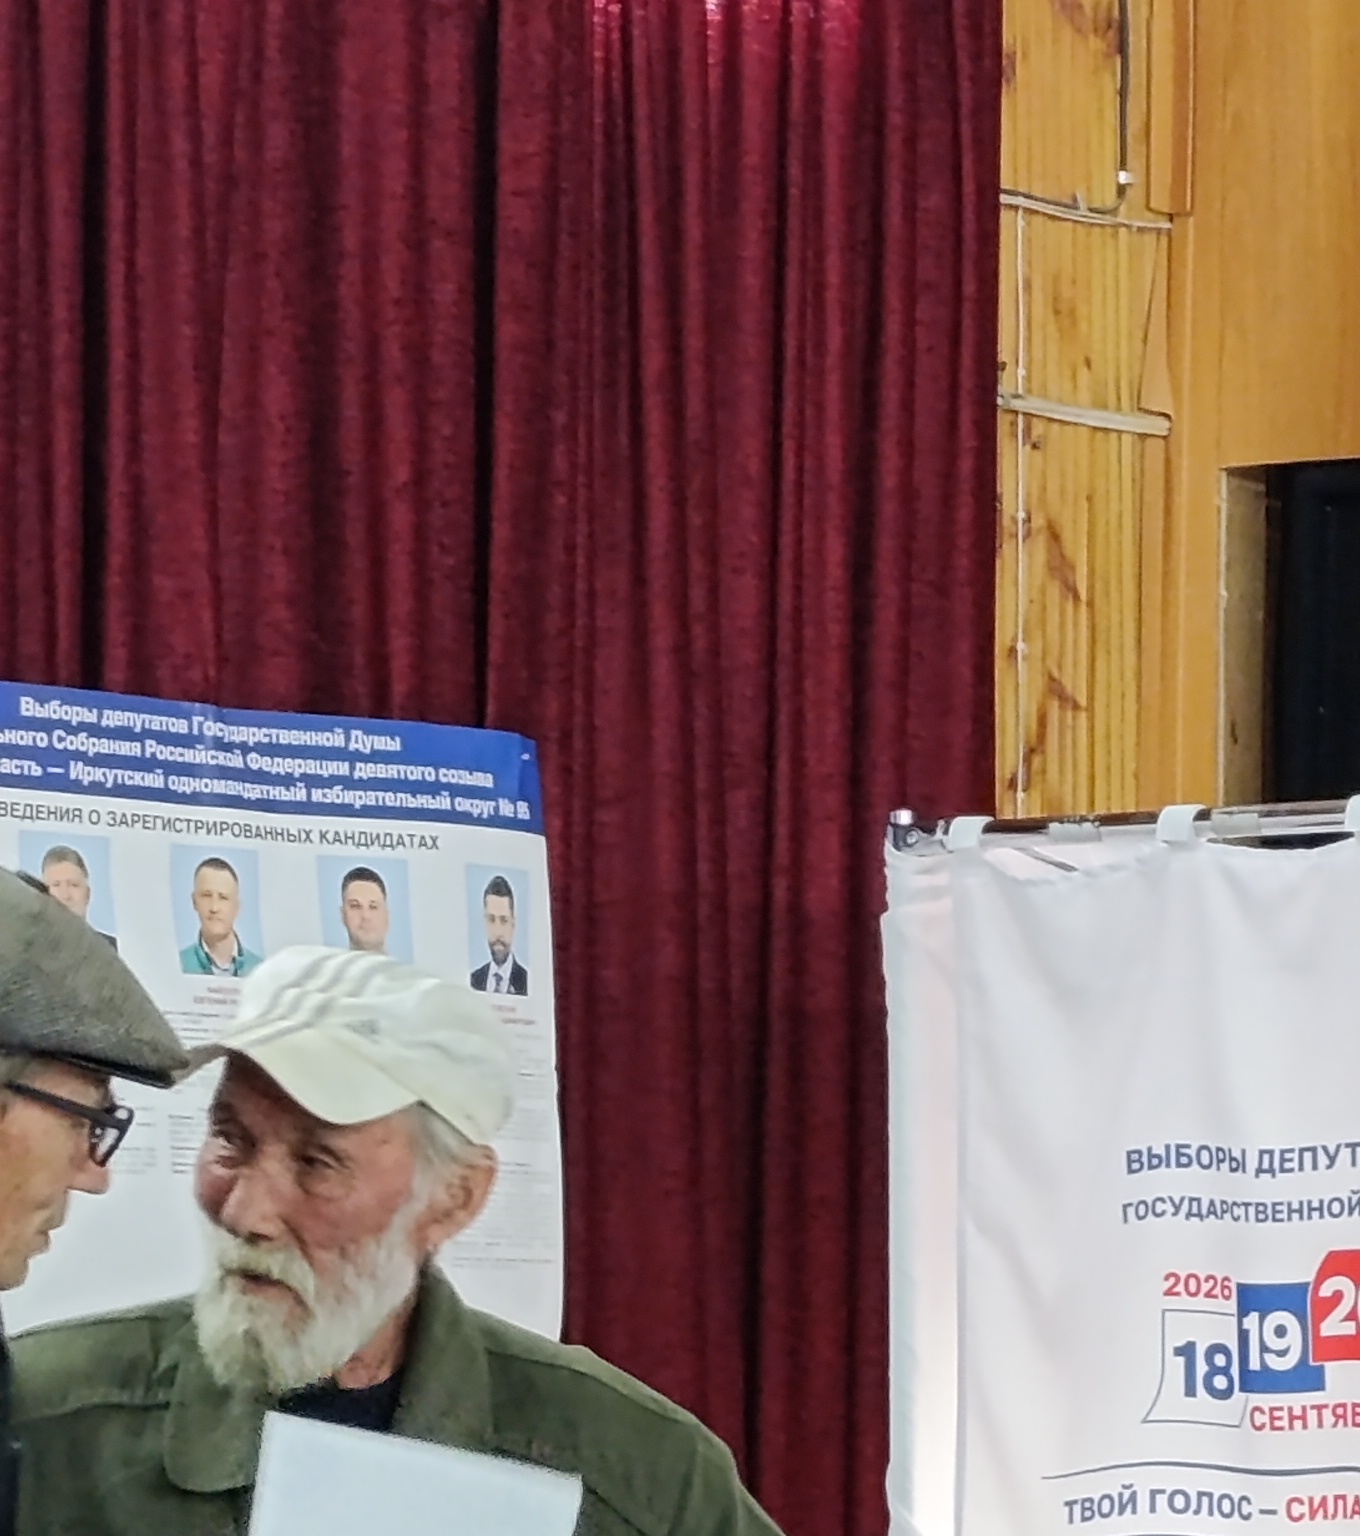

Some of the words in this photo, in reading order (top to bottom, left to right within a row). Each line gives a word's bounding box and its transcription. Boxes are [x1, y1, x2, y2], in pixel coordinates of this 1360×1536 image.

[19, 696, 98, 727] Выборы
[101, 709, 189, 734] депутатов
[191, 715, 345, 749] Государственной
[348, 729, 402, 754] Думы
[52, 729, 141, 758] Собрания
[144, 738, 244, 768] Российской
[246, 752, 351, 779] Федерации
[353, 759, 436, 782] девятого
[69, 760, 165, 790] Иркутский
[311, 786, 452, 811] избирательный
[454, 796, 496, 819] округ
[88, 809, 101, 826] О
[107, 810, 313, 845] ЗАРЕГИСТРИРОВАННЫХ
[319, 828, 439, 852] КАНДИДАТАХ
[1125, 1142, 1247, 1176] ВЫБОРЫ
[1162, 1272, 1233, 1301] 2026
[1241, 1309, 1304, 1372] 19
[1172, 1339, 1235, 1402] 18
[1063, 1483, 1138, 1525] ТВОЙ
[1147, 1487, 1253, 1522] ГОЛОС
